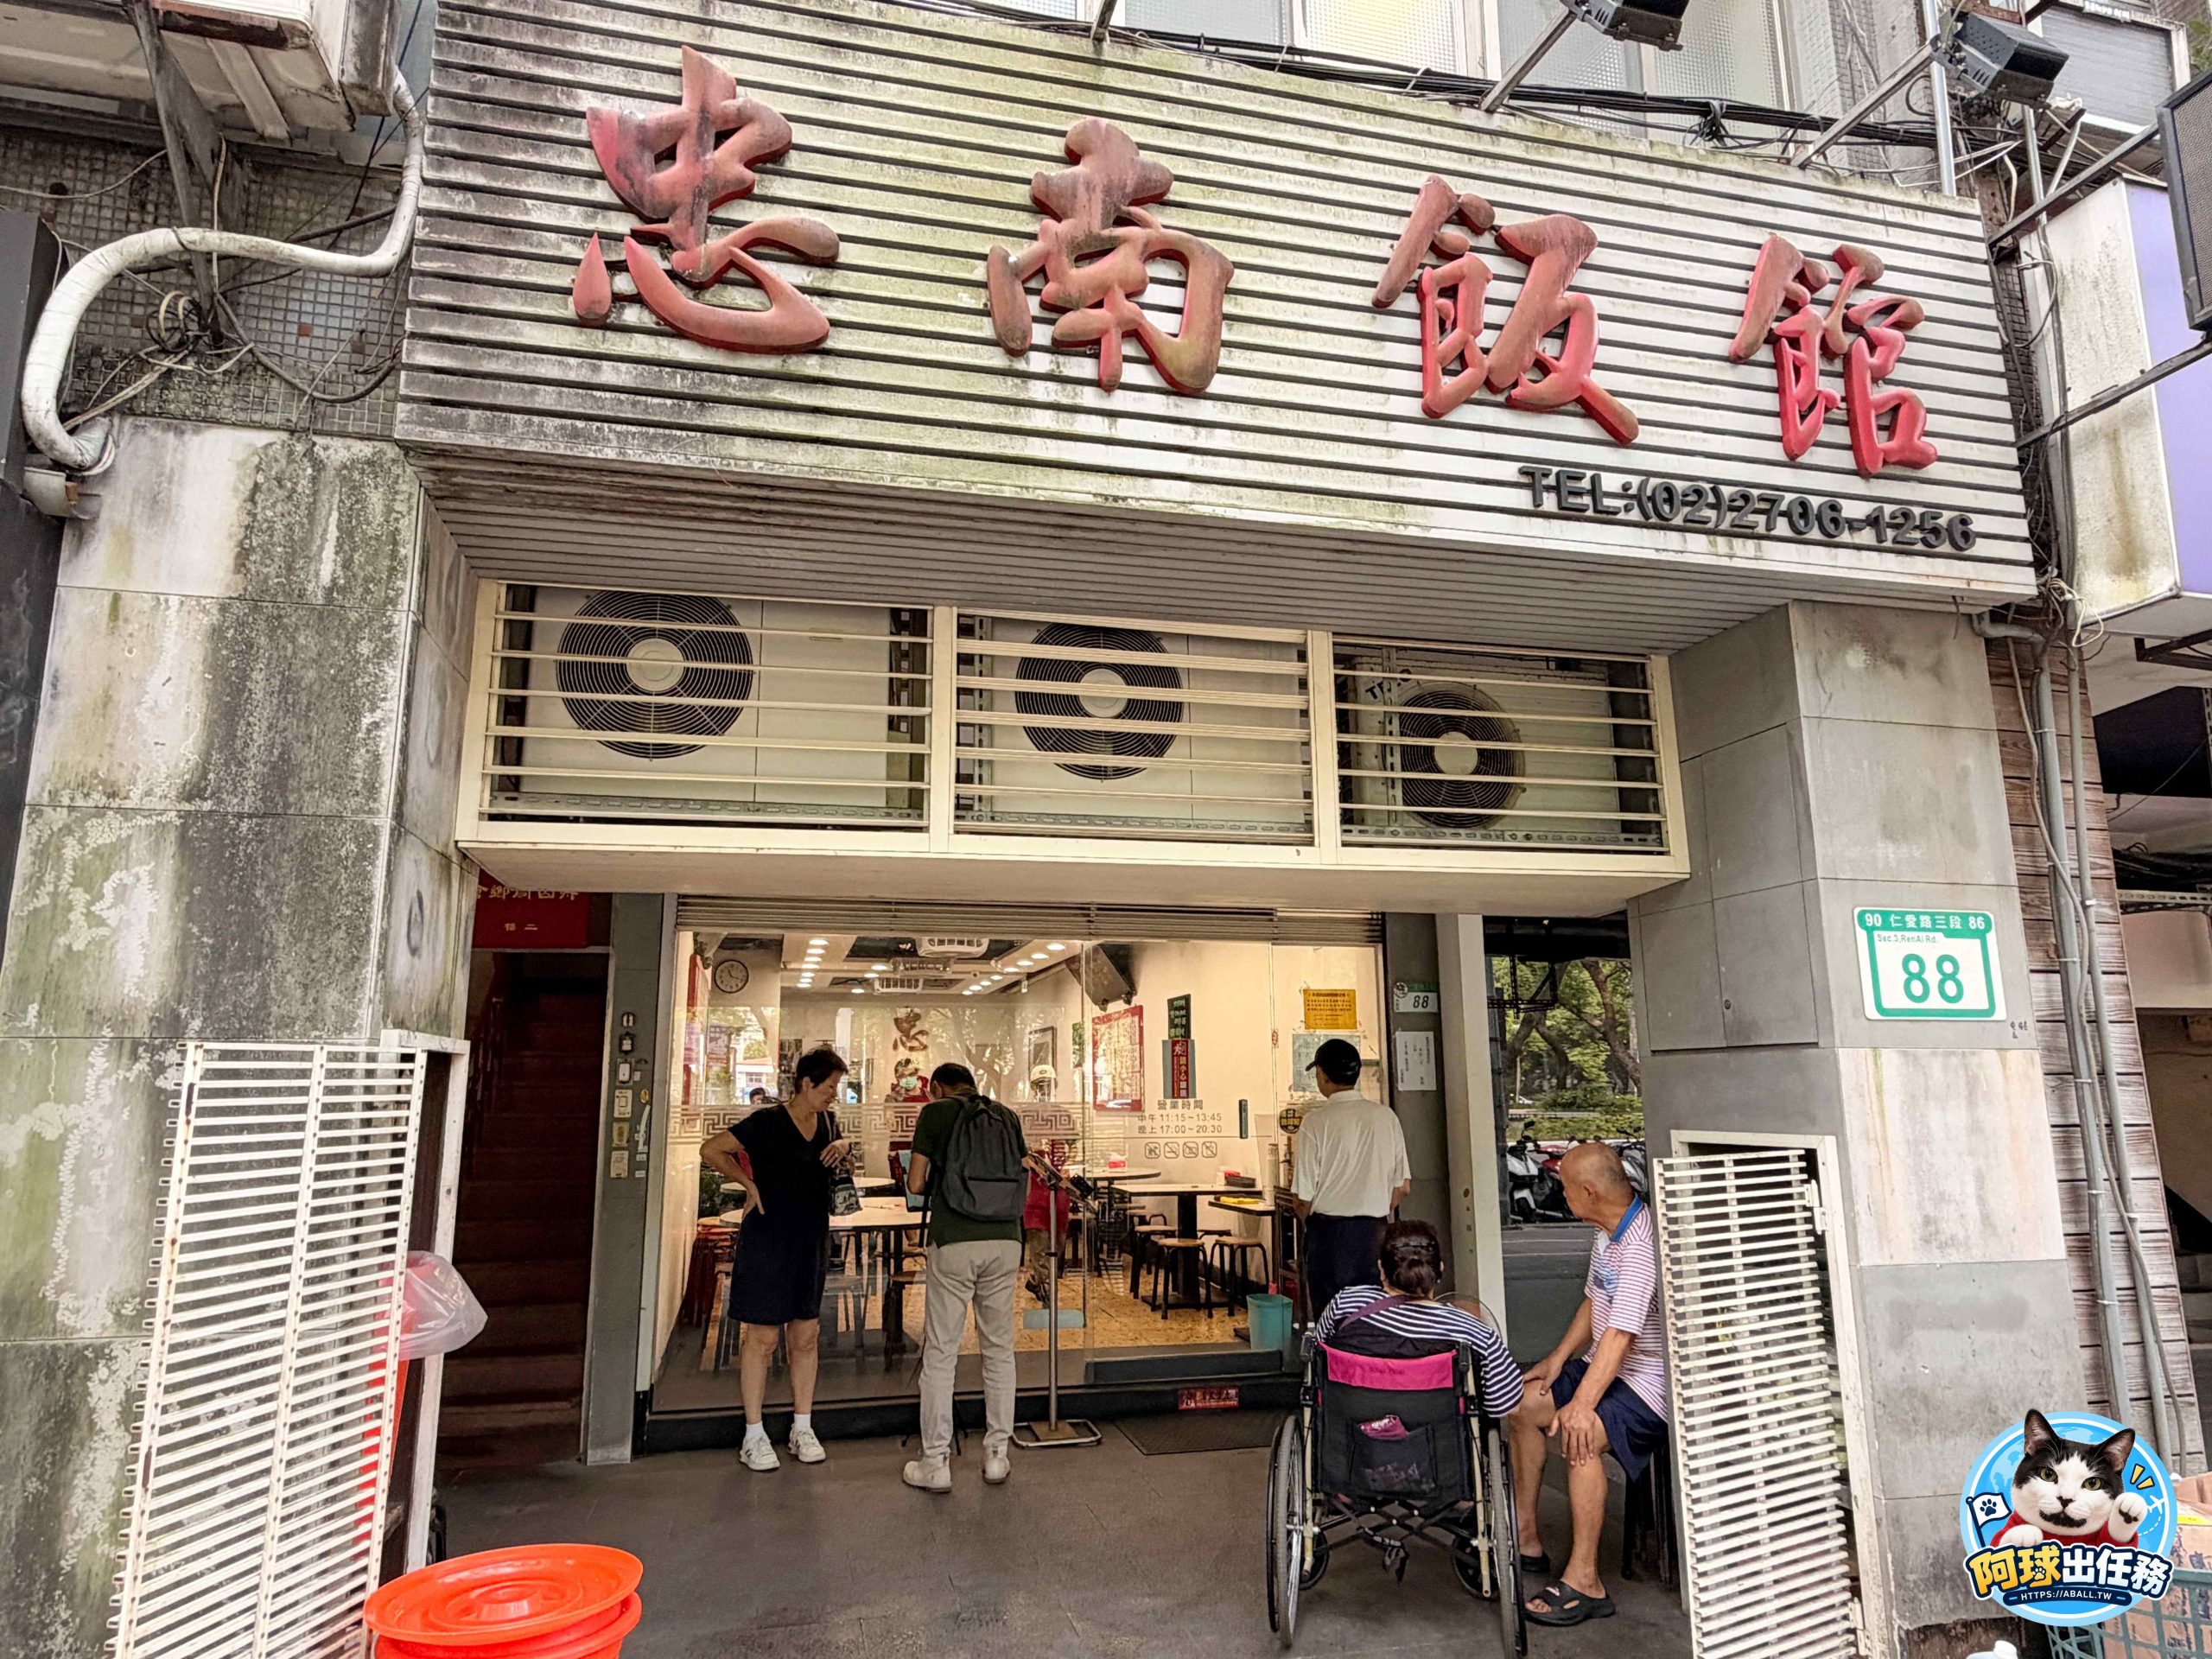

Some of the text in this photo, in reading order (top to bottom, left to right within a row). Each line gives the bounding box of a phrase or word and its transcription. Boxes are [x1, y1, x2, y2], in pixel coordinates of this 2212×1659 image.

[571, 45, 1938, 478] 忠南飯館
[1865, 912, 1986, 930] 90 仁愛路三段 86
[1902, 952, 1964, 1004] 88
[1413, 995, 1429, 1009] 88
[1157, 1099, 1204, 1110] 營業時間
[1137, 1114, 1157, 1122] 中午
[1137, 1125, 1157, 1134] 晚上
